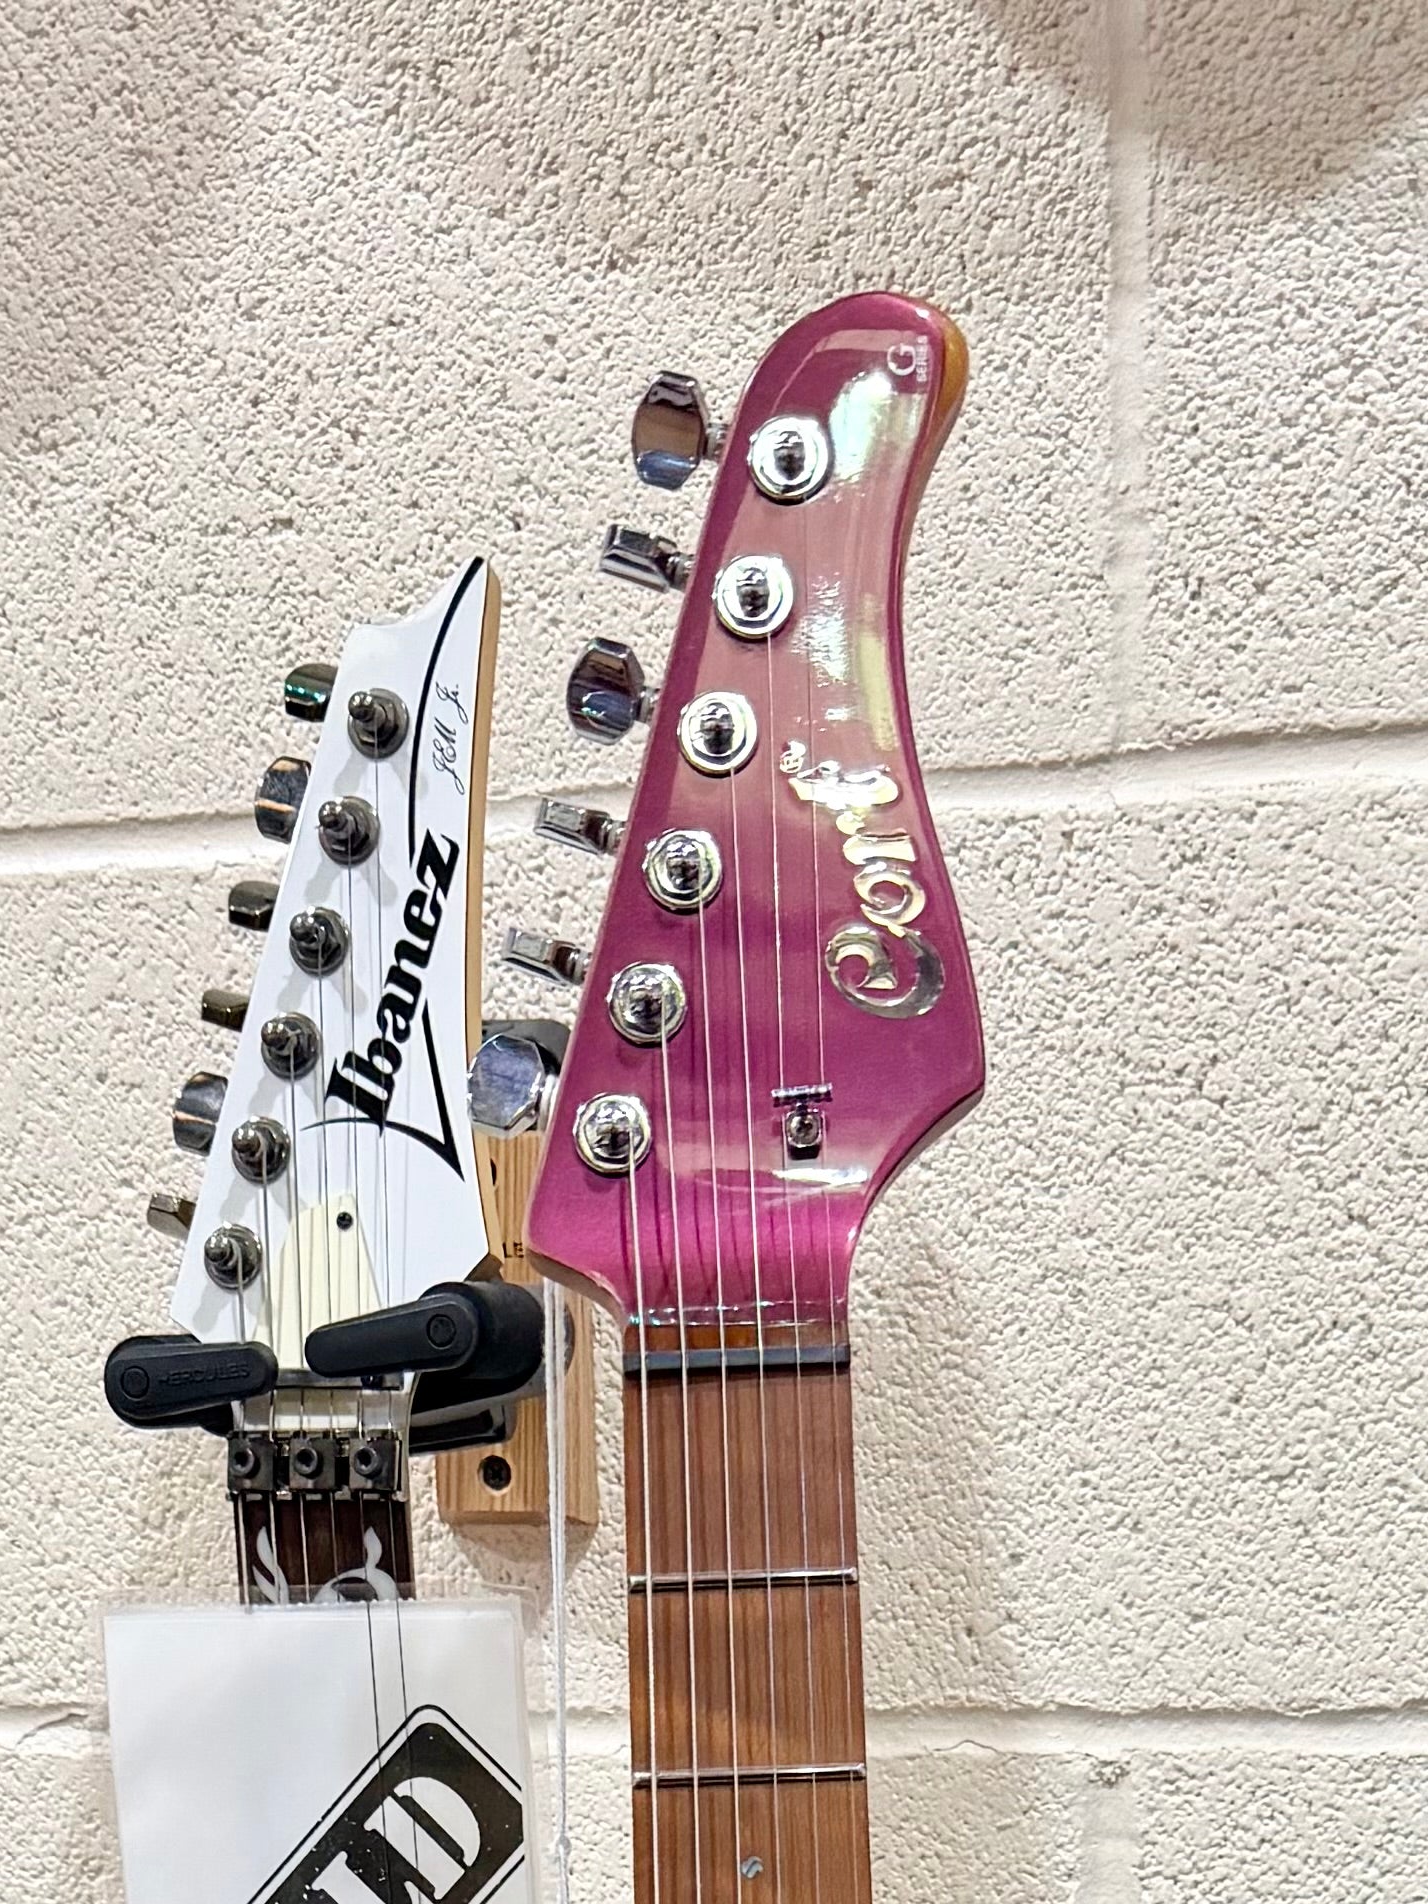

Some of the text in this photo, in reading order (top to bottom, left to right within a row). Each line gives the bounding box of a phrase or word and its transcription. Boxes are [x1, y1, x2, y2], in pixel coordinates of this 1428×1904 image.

[887, 343, 917, 376] G
[434, 717, 466, 795] JEM
[324, 828, 460, 1138] Ibanez
